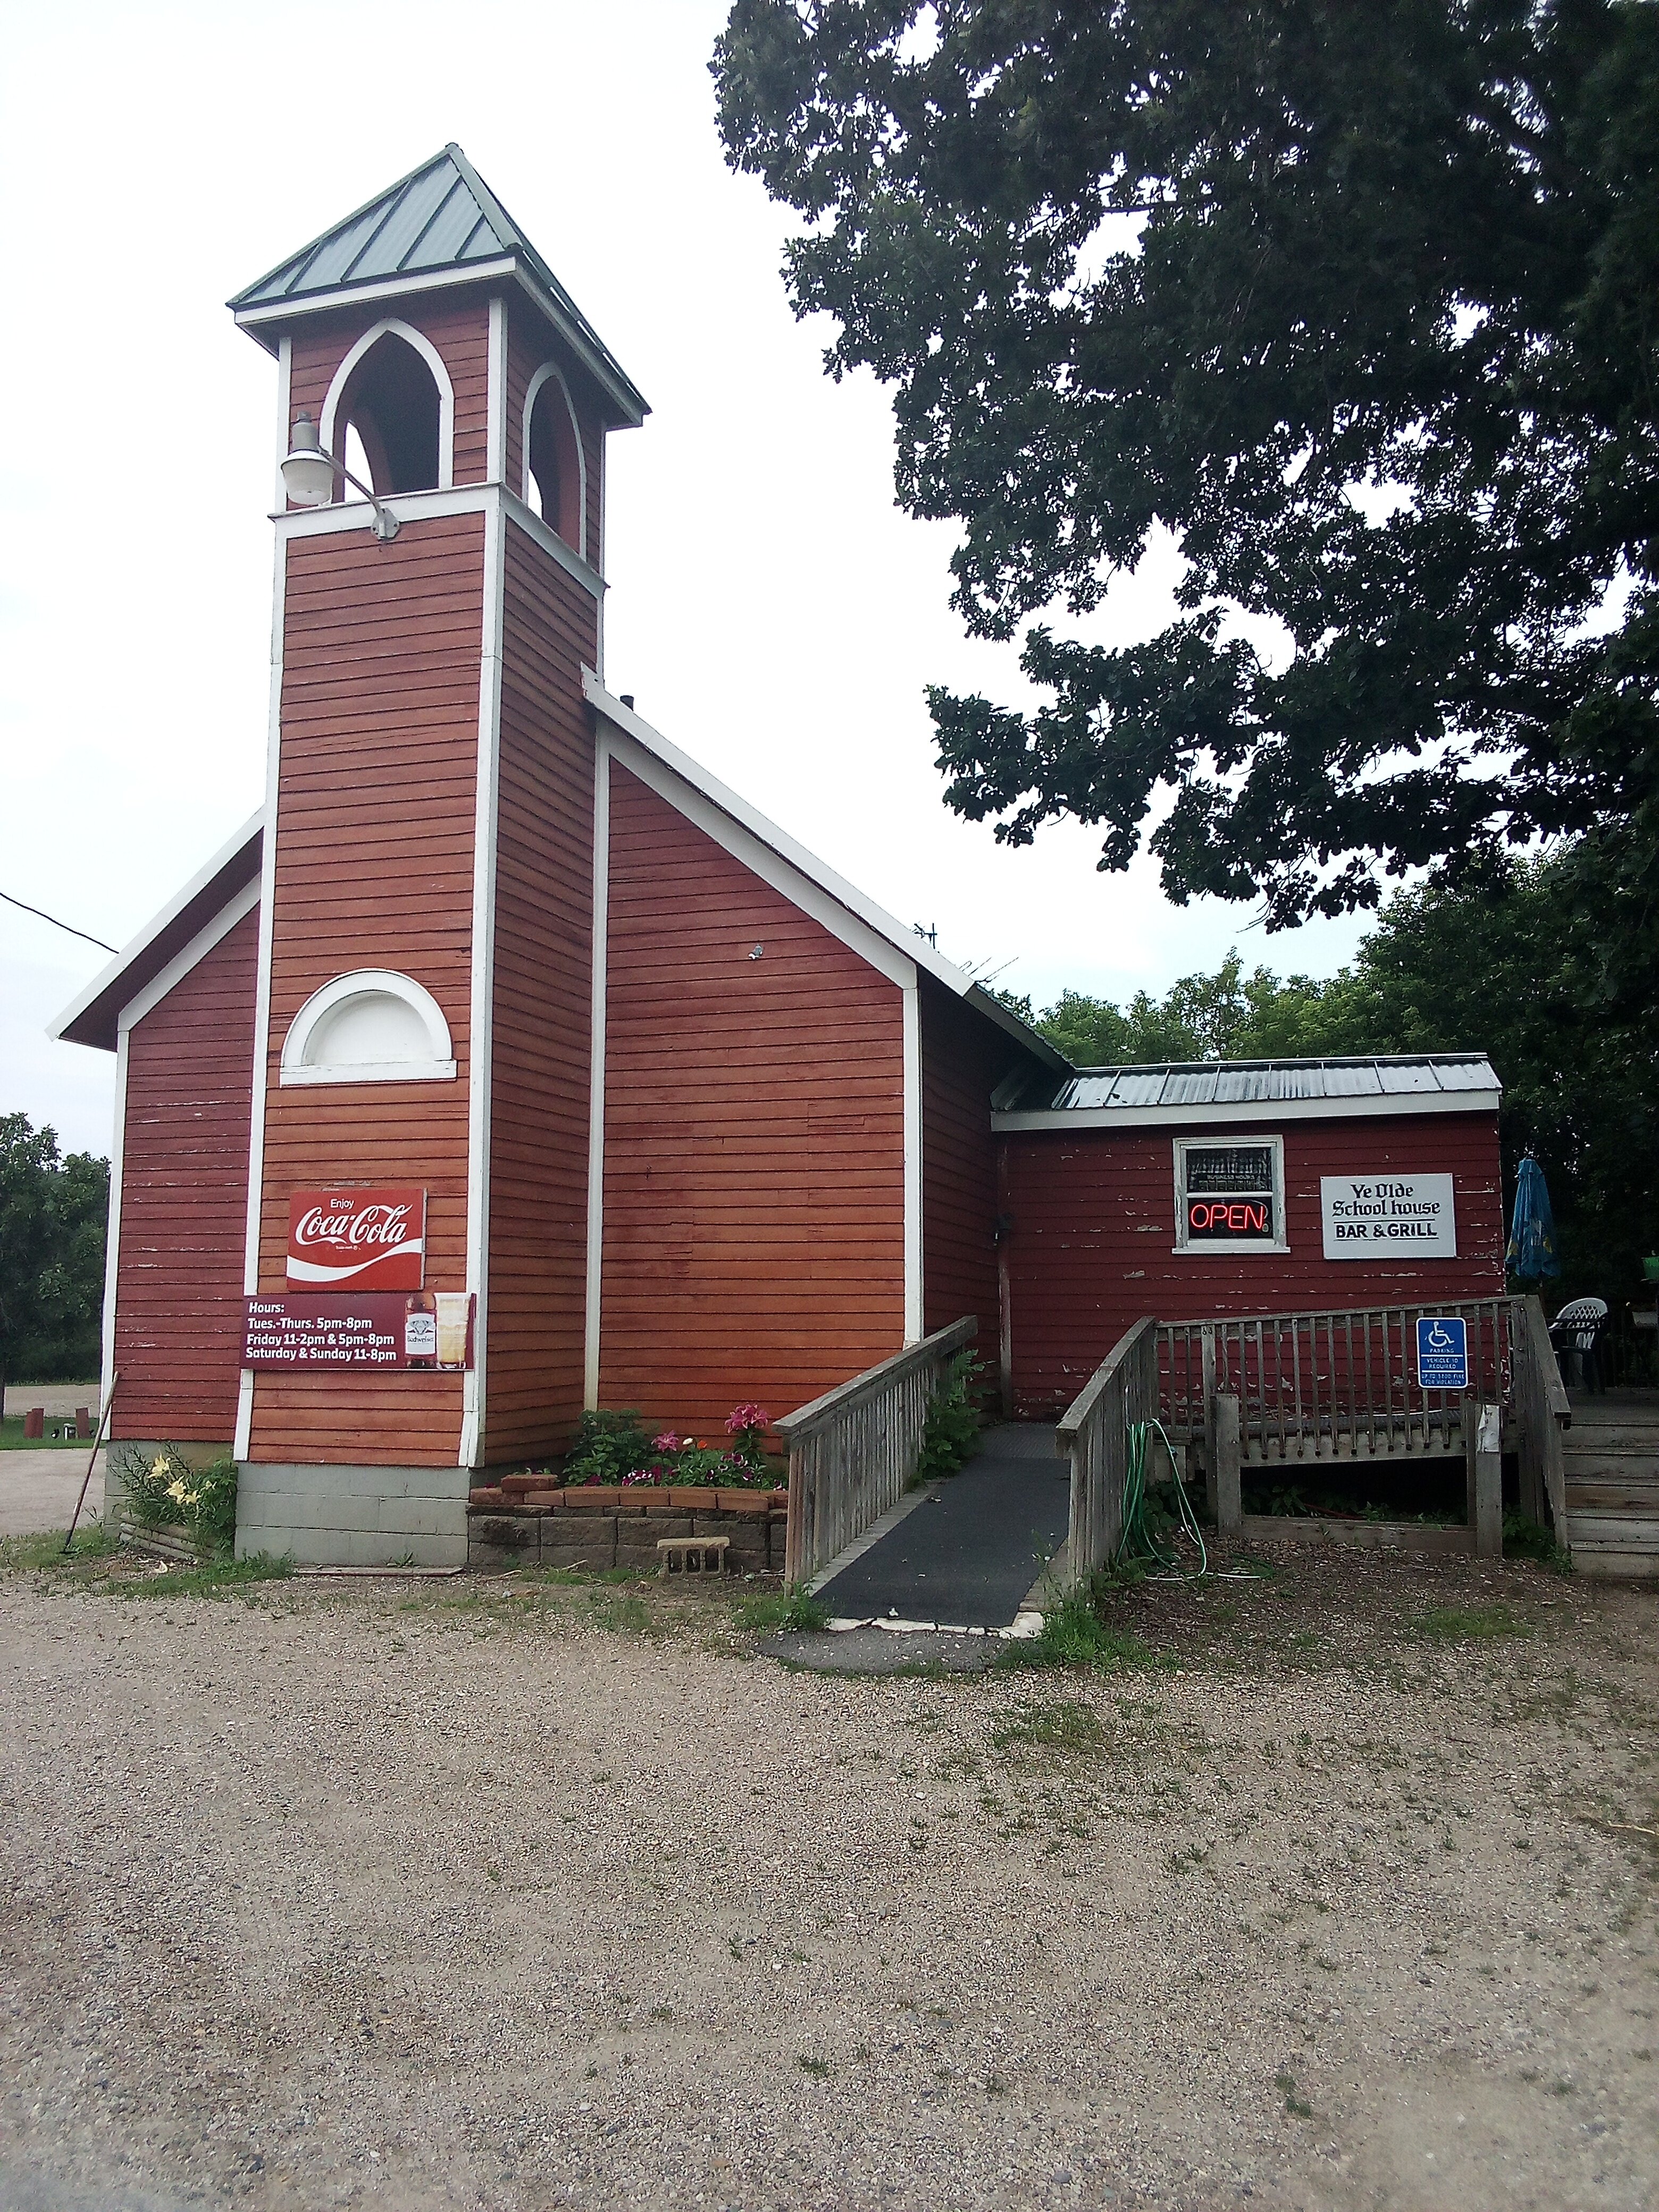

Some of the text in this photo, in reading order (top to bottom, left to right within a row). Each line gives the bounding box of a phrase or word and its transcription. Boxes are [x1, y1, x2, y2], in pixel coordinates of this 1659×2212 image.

[1350, 1183, 1414, 1199] Ye Olde
[330, 1198, 355, 1210] Enjoy
[1332, 1200, 1440, 1217] School house
[1191, 1204, 1263, 1229] OPEN
[295, 1204, 413, 1245] Coca-Cola
[1336, 1223, 1437, 1238] BAR & GRILL
[249, 1302, 284, 1313] Hours:
[247, 1317, 372, 1331] Tues.-Thurs. 5pm-8pm
[247, 1333, 395, 1347] Friday 11-2pm & 5pm-8pm
[246, 1347, 397, 1362] Saturday & Sunday 11-8pm
